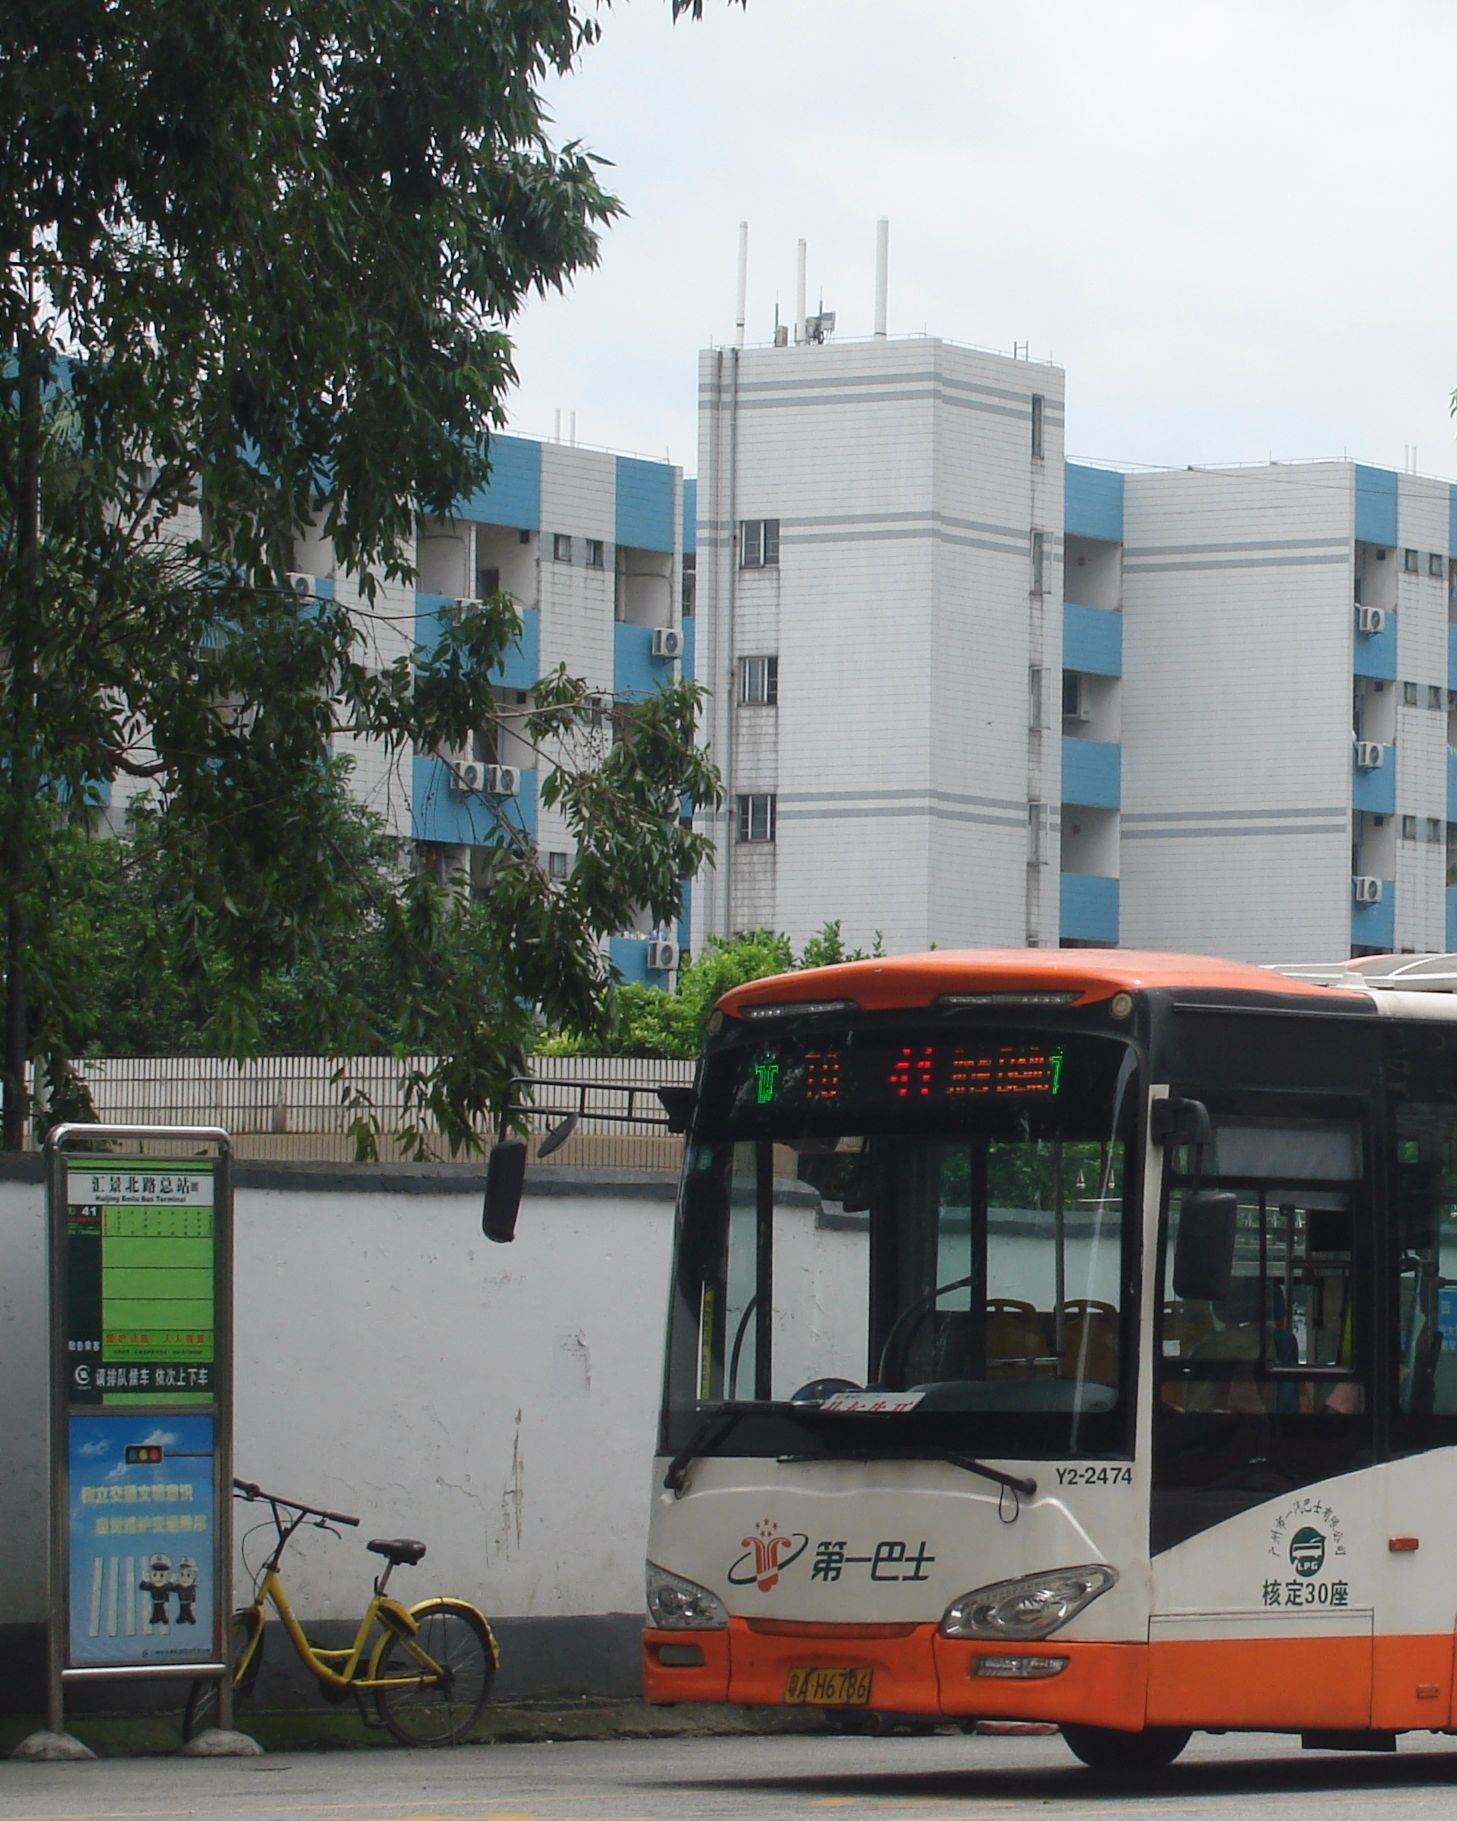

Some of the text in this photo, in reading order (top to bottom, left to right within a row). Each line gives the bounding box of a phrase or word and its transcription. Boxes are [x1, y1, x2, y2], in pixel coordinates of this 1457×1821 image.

[92, 1176, 190, 1194] 汇景北路总站
[81, 1206, 97, 1216] 41
[96, 1368, 209, 1387] 请排队候车 依次上下车
[1056, 1467, 1133, 1485] Y2-2474
[811, 1541, 935, 1582] 第一巴士
[1297, 1561, 1318, 1571] LPG
[1262, 1579, 1349, 1606] 核定30座
